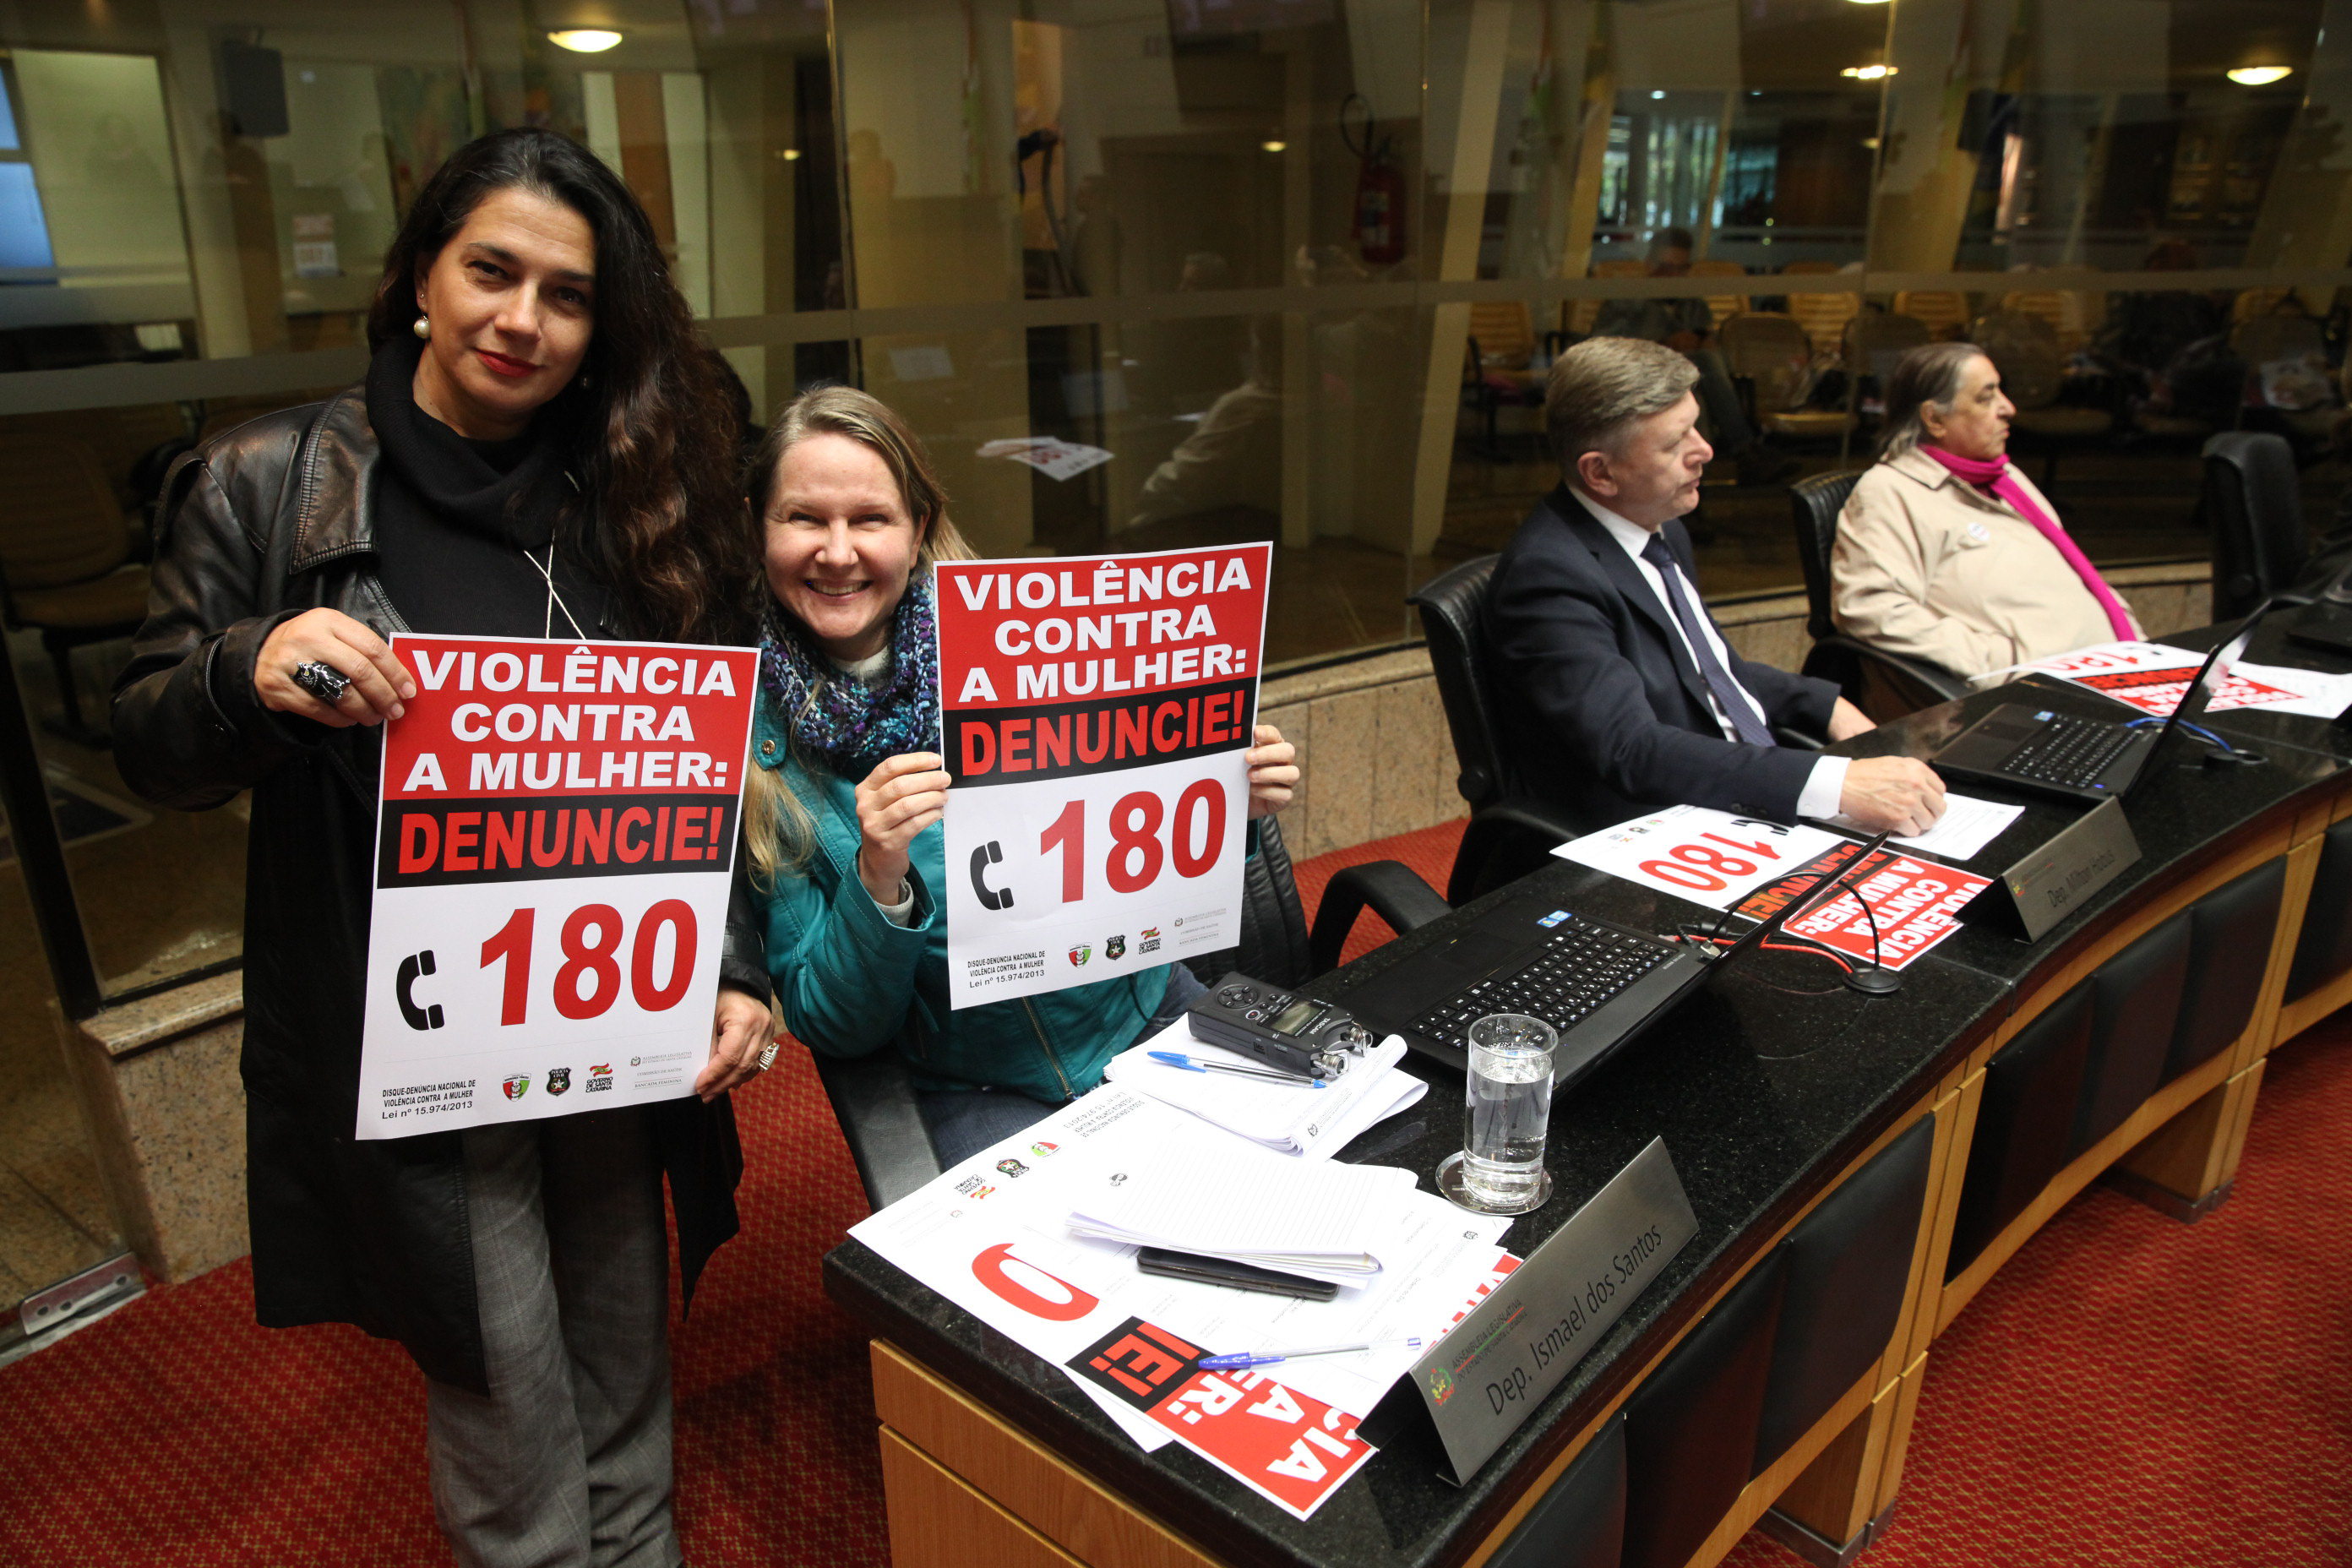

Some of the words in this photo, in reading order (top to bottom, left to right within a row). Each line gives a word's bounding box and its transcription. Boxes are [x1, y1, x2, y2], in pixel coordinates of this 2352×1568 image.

[954, 557, 1251, 612] VIOLÊNCIA
[995, 604, 1217, 656] CONTRA
[412, 646, 736, 697] VIOLÊNCIA
[958, 667, 999, 703] A
[1017, 643, 1247, 700] MULHER:
[451, 703, 695, 742] CONTRA
[961, 689, 1245, 776] DENUNCIE!
[402, 753, 448, 791] A
[469, 752, 727, 790] MULHER:
[398, 807, 724, 874] DENUNCIE!
[1040, 778, 1227, 903] 180
[1638, 832, 1783, 892] 180
[1891, 859, 1925, 874] A
[1794, 872, 1910, 934] MULHER:
[1844, 879, 1948, 937] CONTRA
[480, 899, 698, 1026] 180
[967, 956, 1012, 968] DISQUE-DENÚNCIA
[1014, 951, 1037, 961] NACIONAL
[970, 966, 996, 977] VIOLÊNCIA
[997, 963, 1016, 972] CONTRA
[1024, 960, 1044, 968] MULHER
[970, 980, 983, 988] Lei
[996, 969, 1045, 983] 15.974/2013
[1309, 1017, 1331, 1034] TASCAM
[382, 1110, 397, 1119] Lei
[415, 1101, 472, 1115] 15.974/2013
[383, 1084, 436, 1097] DISQUE-DENÚNCIA
[438, 1081, 466, 1091] NACIONAL
[384, 1097, 416, 1108] VIOLÊNCIA
[417, 1094, 441, 1103] CONTRA
[449, 1090, 473, 1100] MULHER
[1485, 1366, 1533, 1416] Dep.
[1530, 1295, 1587, 1371] Ismael
[1587, 1273, 1616, 1315] dos
[1613, 1224, 1663, 1284] Santos
[1487, 1298, 1522, 1336] LEGISLATIVA
[1246, 1383, 1305, 1424] A
